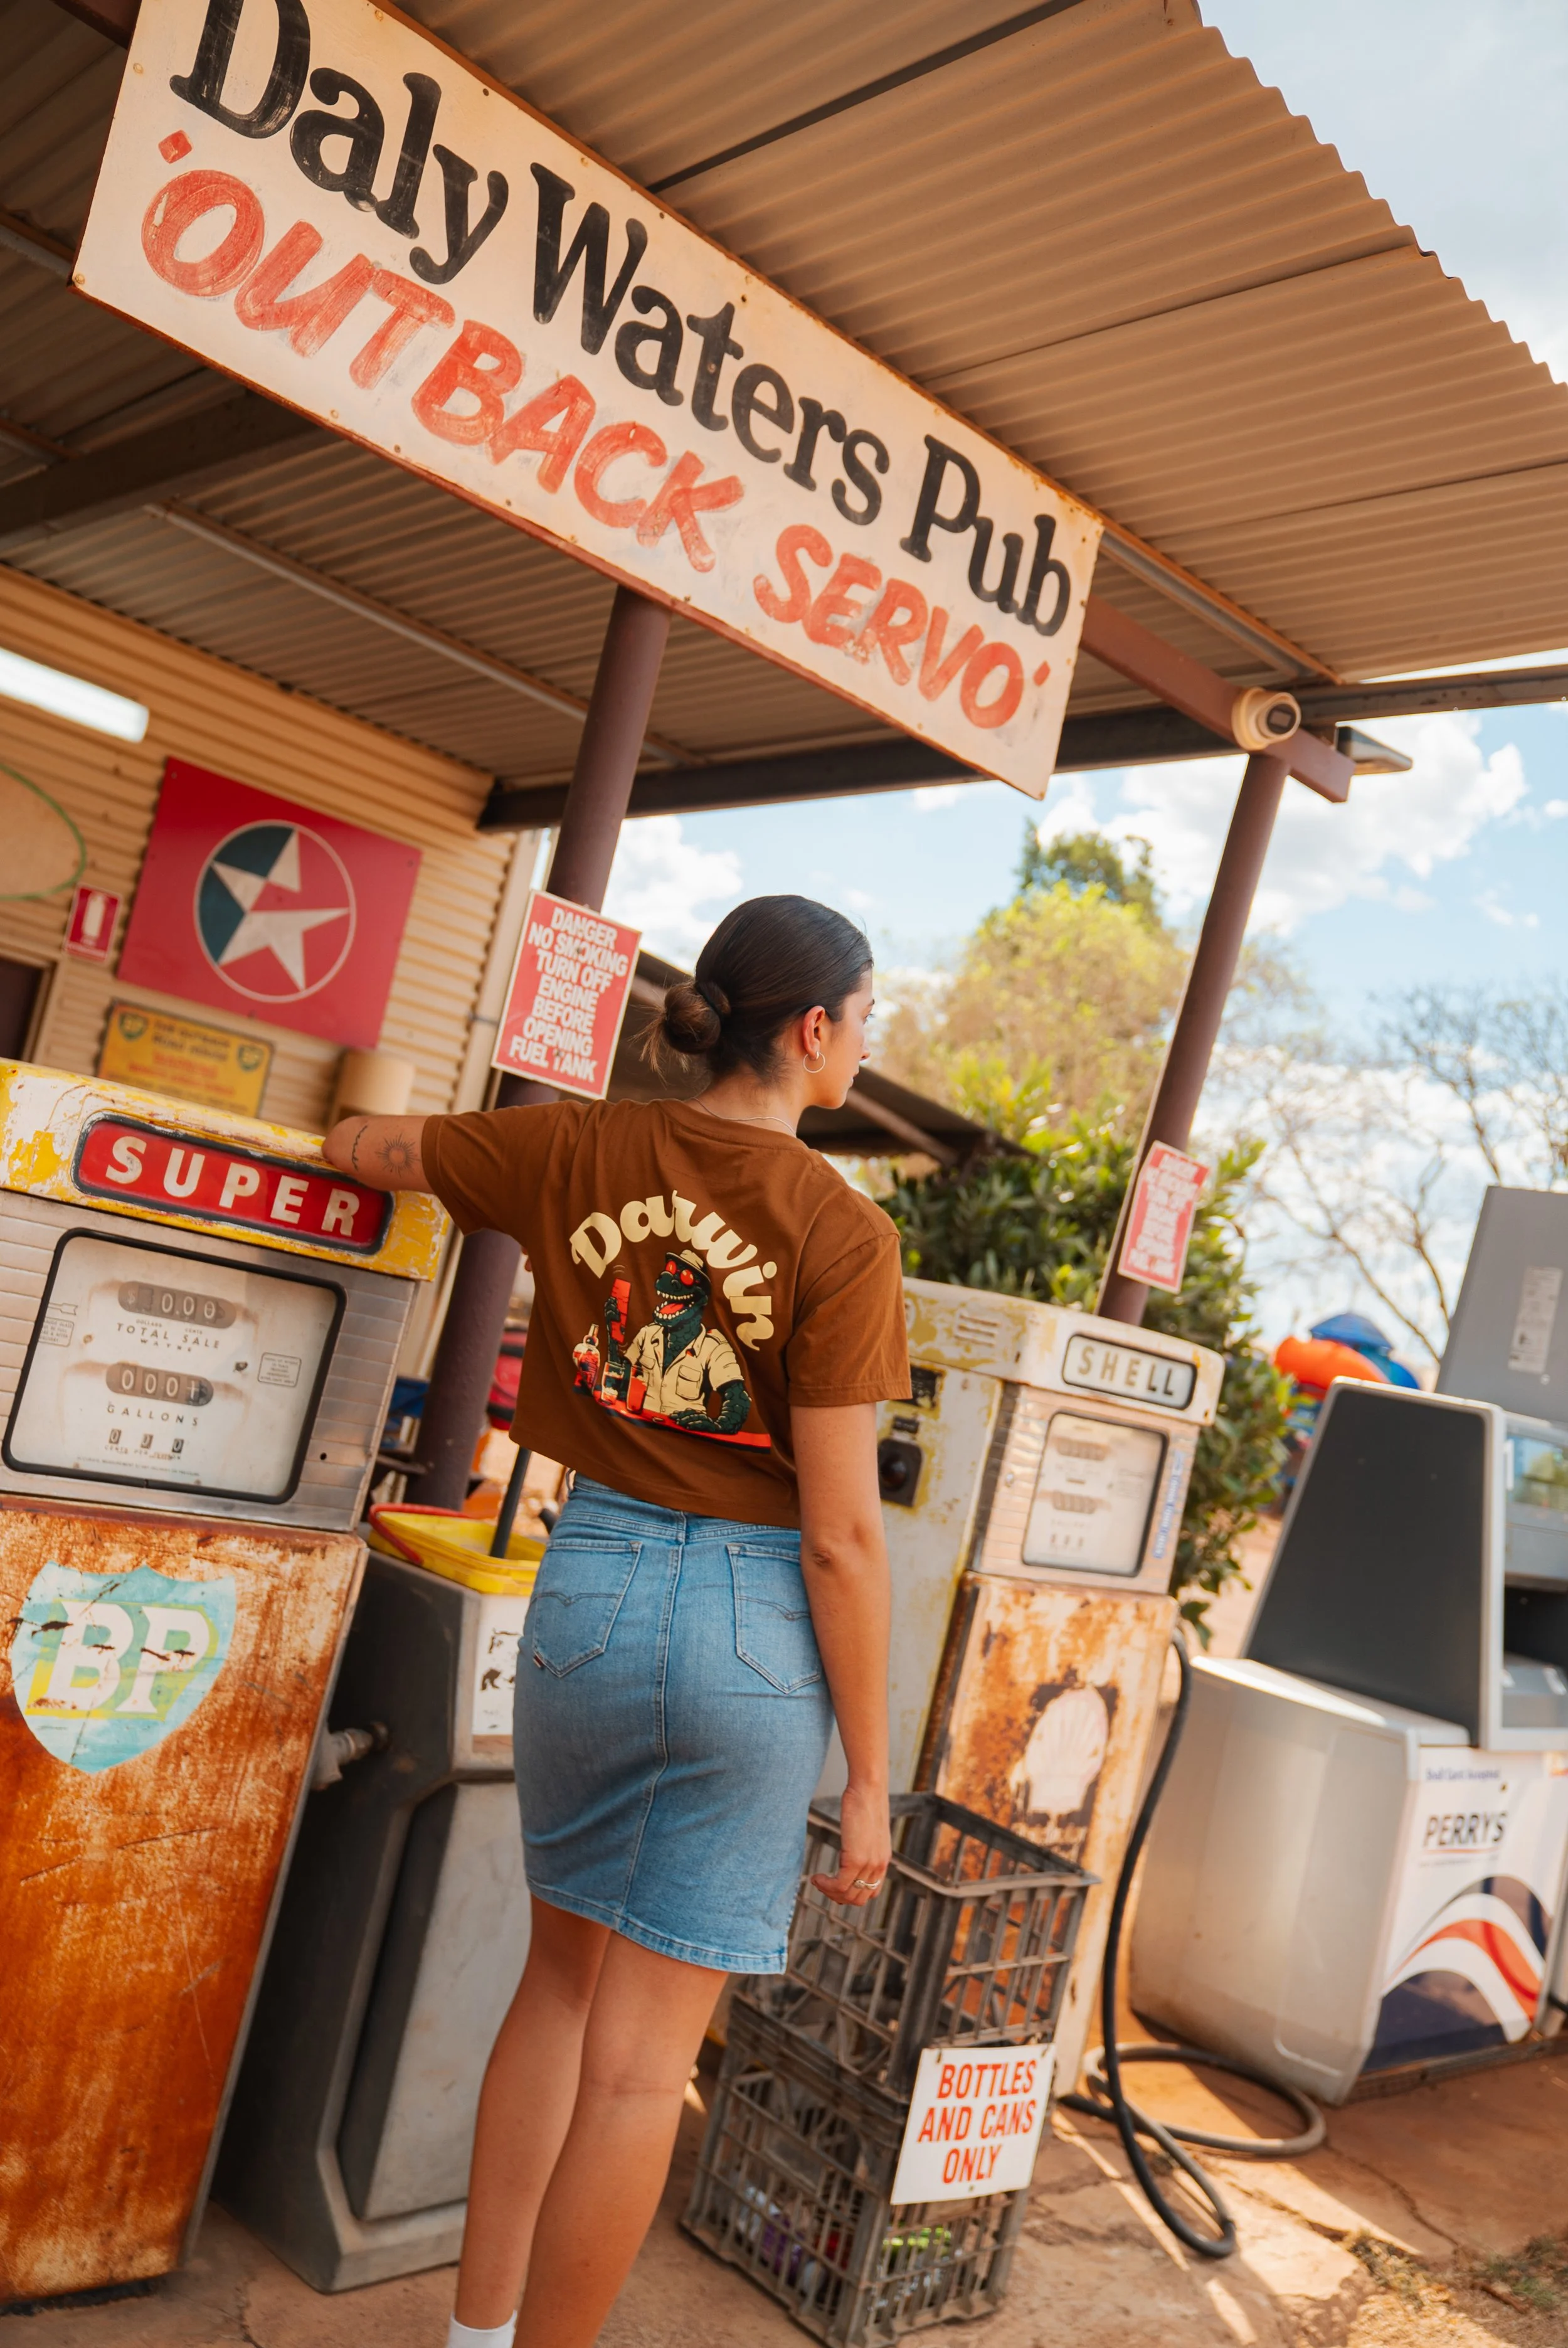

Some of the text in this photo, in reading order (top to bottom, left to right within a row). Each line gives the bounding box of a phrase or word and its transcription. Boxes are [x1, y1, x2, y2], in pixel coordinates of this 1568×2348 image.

[170, 0, 1071, 637] Daly Waters Pub
[551, 906, 617, 949] DANGER
[528, 922, 628, 977] NO SMOKING
[536, 948, 613, 994] TURN OFF
[538, 974, 599, 1011] ENGINE
[532, 994, 595, 1035] BEFORE
[509, 1035, 598, 1082] FUEL TANK
[522, 1017, 593, 1058] OPENING
[105, 1135, 360, 1236] SUPER
[569, 1190, 777, 1351] Darwin
[117, 1322, 220, 1349] TOTAL SALE
[140, 1338, 191, 1352] WAYNE
[1078, 1346, 1173, 1396] SHELL
[107, 1404, 198, 1426] GALLONS
[27, 1600, 209, 1714] BP
[1423, 1811, 1508, 1847] PERRYS
[937, 2060, 1037, 2099] BOTTLES
[916, 2100, 1037, 2143] AND CANS
[943, 2143, 1002, 2184] ONLY
